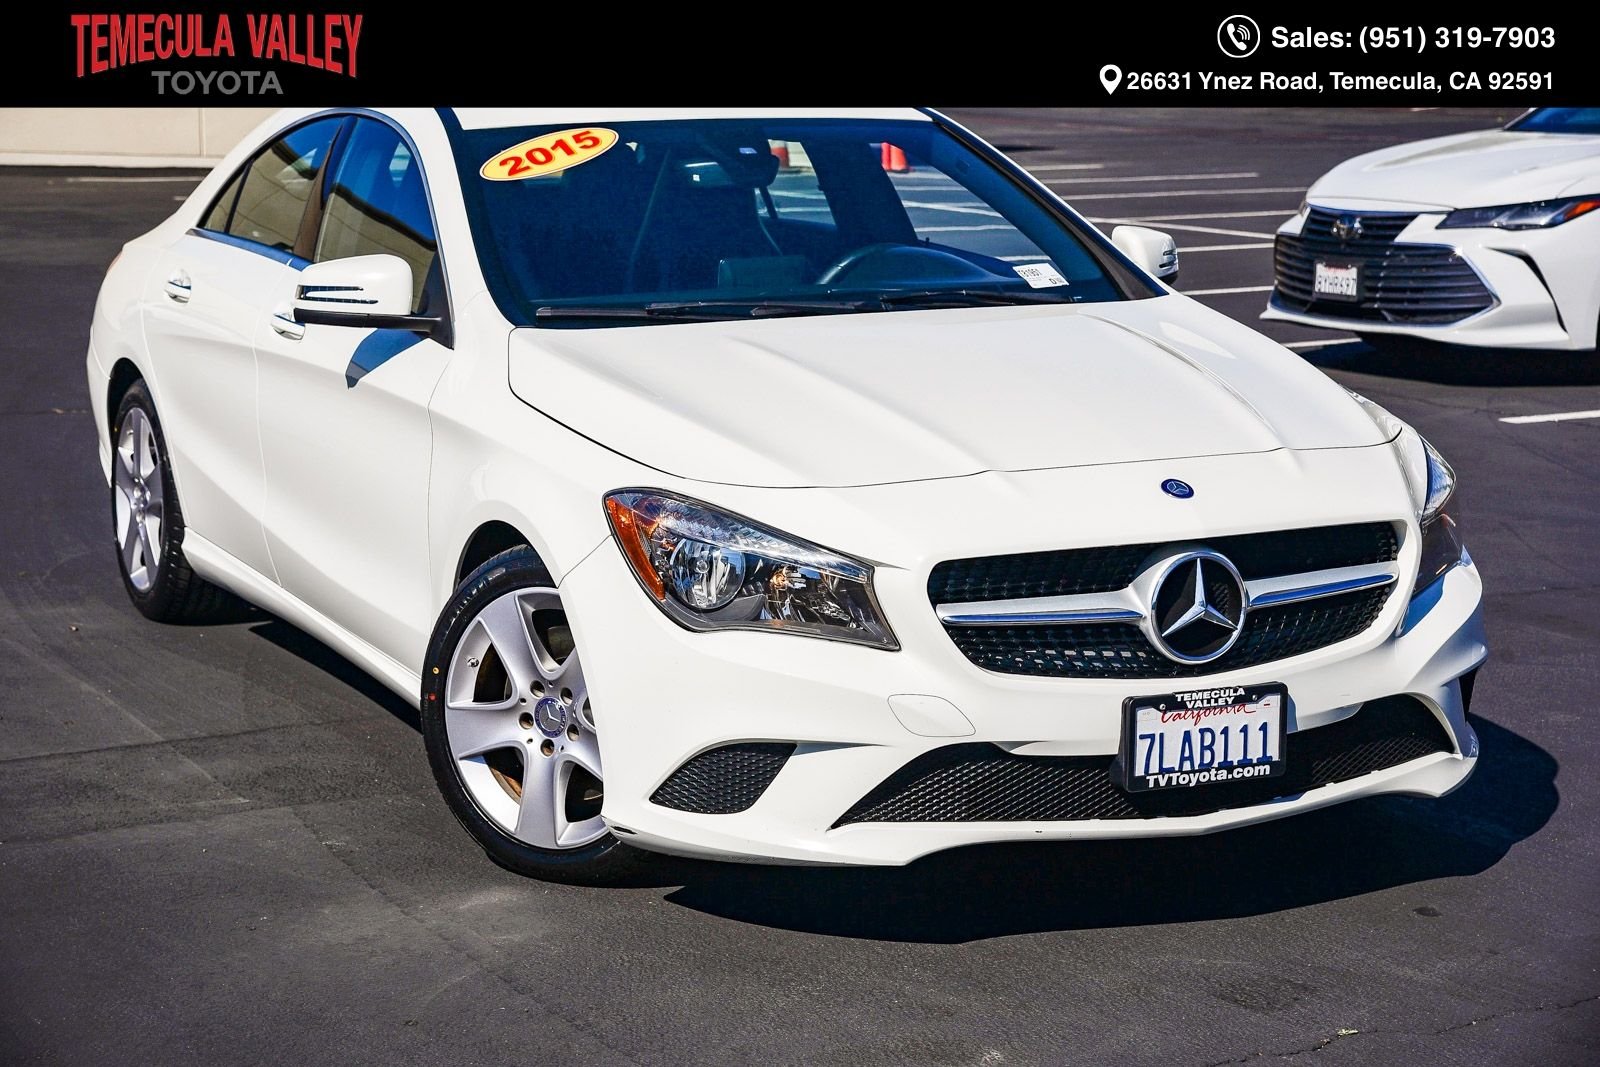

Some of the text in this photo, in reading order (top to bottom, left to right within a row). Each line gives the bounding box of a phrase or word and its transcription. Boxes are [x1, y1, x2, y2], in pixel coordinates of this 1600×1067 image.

[499, 130, 602, 176] 2015
[1175, 687, 1245, 702] TEMECULA
[1185, 697, 1235, 709] VALLEY
[1139, 722, 1273, 776] 7LAB111
[1146, 764, 1270, 788] TVToyota.com
